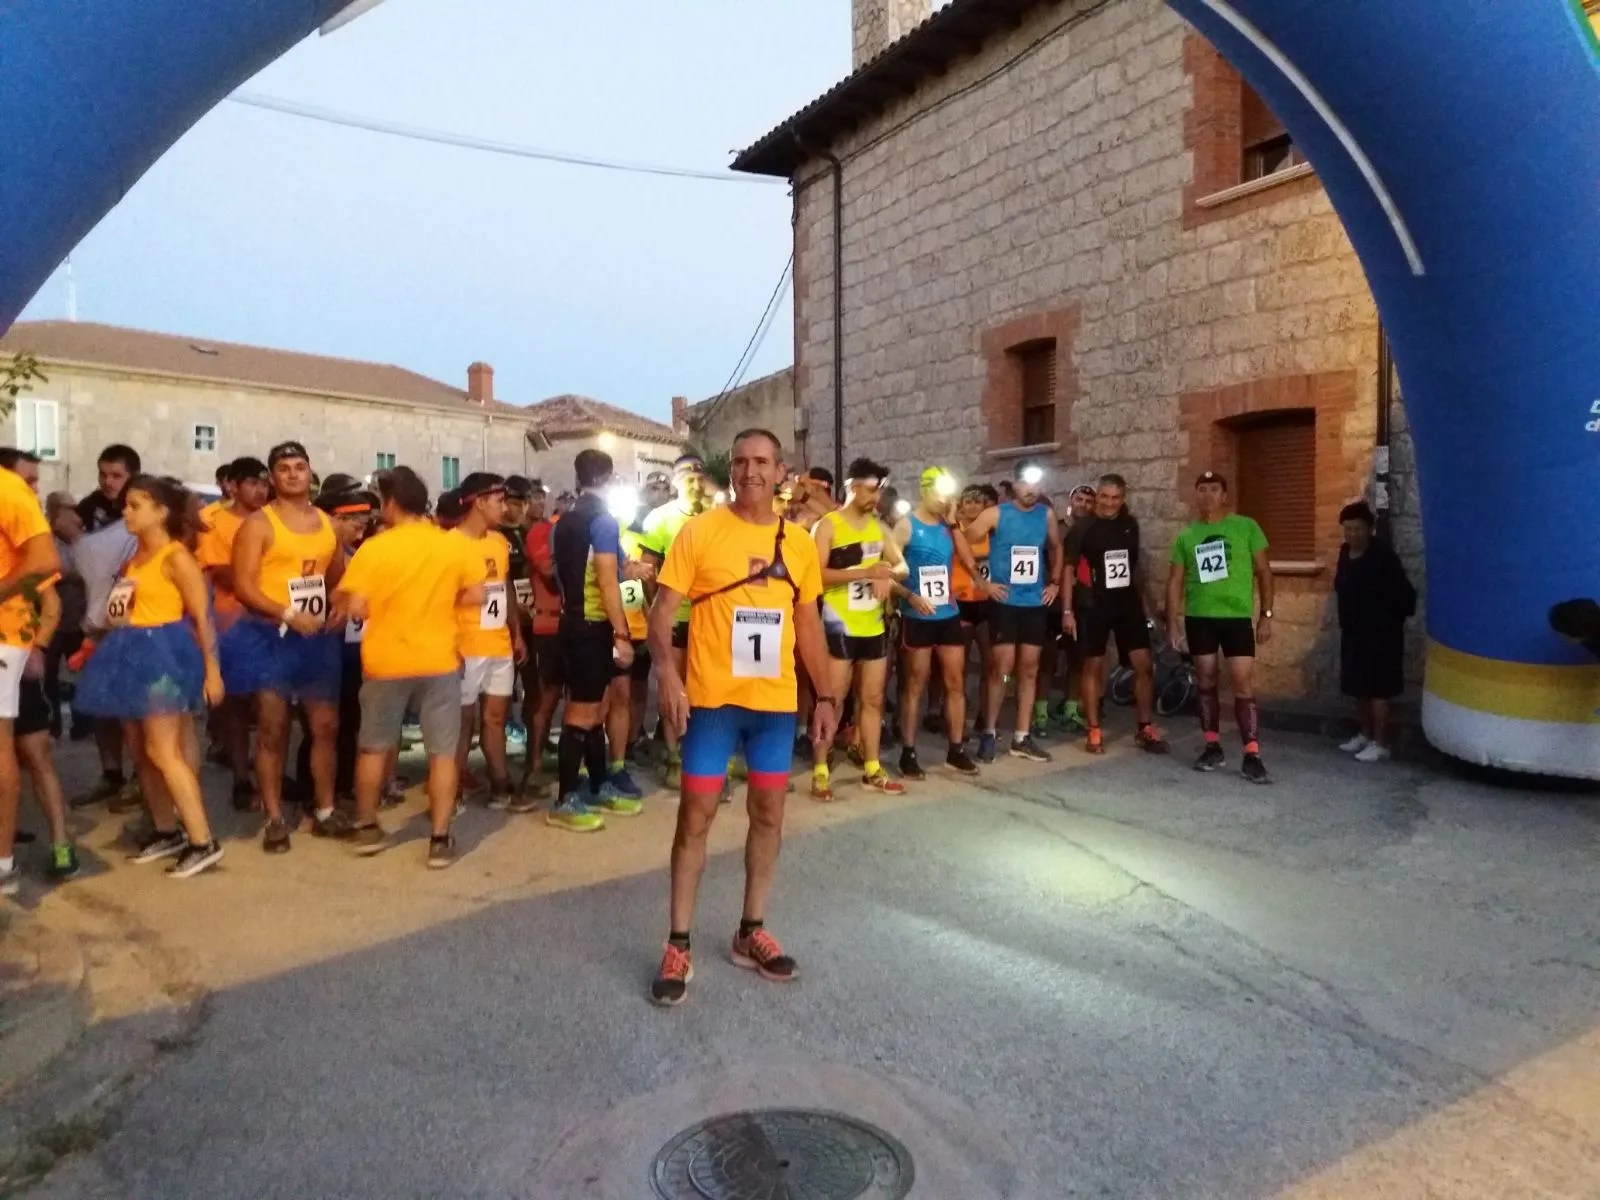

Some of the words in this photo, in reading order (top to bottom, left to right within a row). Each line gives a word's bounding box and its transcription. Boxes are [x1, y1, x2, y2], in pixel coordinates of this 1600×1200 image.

[1014, 560, 1033, 576] 41
[1108, 563, 1128, 579] 32
[1200, 554, 1224, 572] 42
[625, 587, 636, 603] 3
[924, 581, 945, 597] 13
[294, 596, 323, 616] 70
[487, 600, 499, 618] 4
[748, 633, 762, 662] 1
